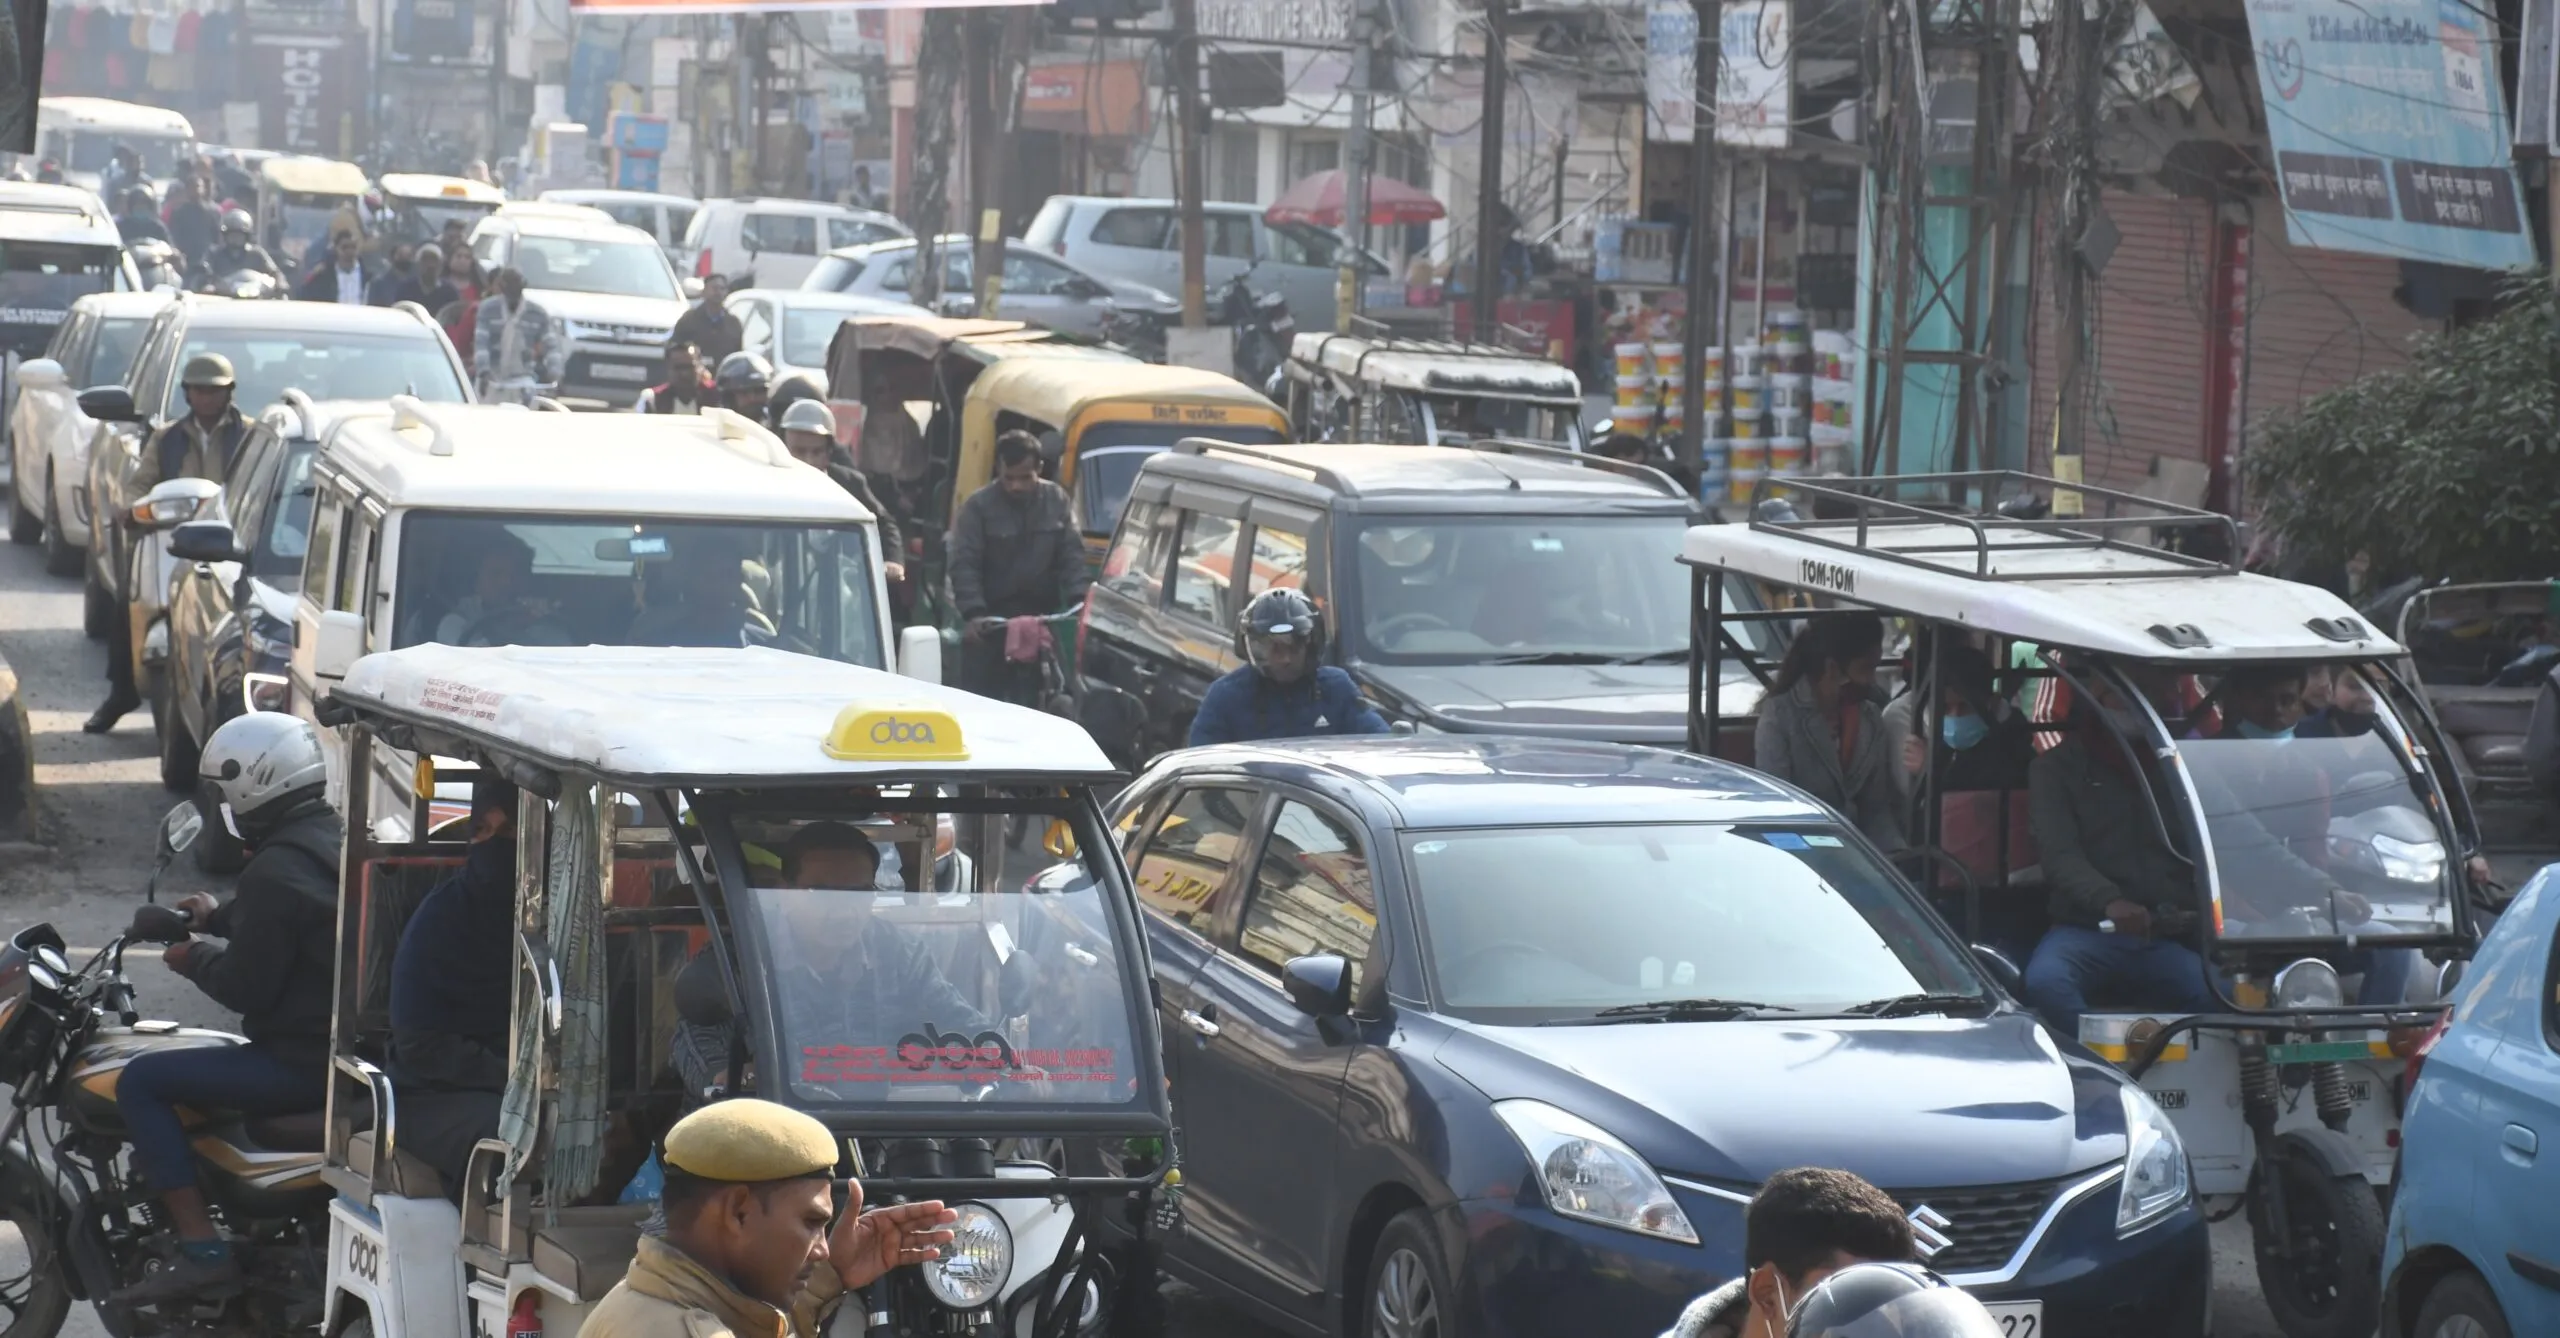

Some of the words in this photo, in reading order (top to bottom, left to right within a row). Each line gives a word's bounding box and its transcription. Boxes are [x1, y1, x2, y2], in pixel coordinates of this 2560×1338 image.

[282, 49, 321, 147] HOTEL
[1802, 558, 1854, 593] TOM-TOM
[2001, 1314, 2037, 1338] 22
